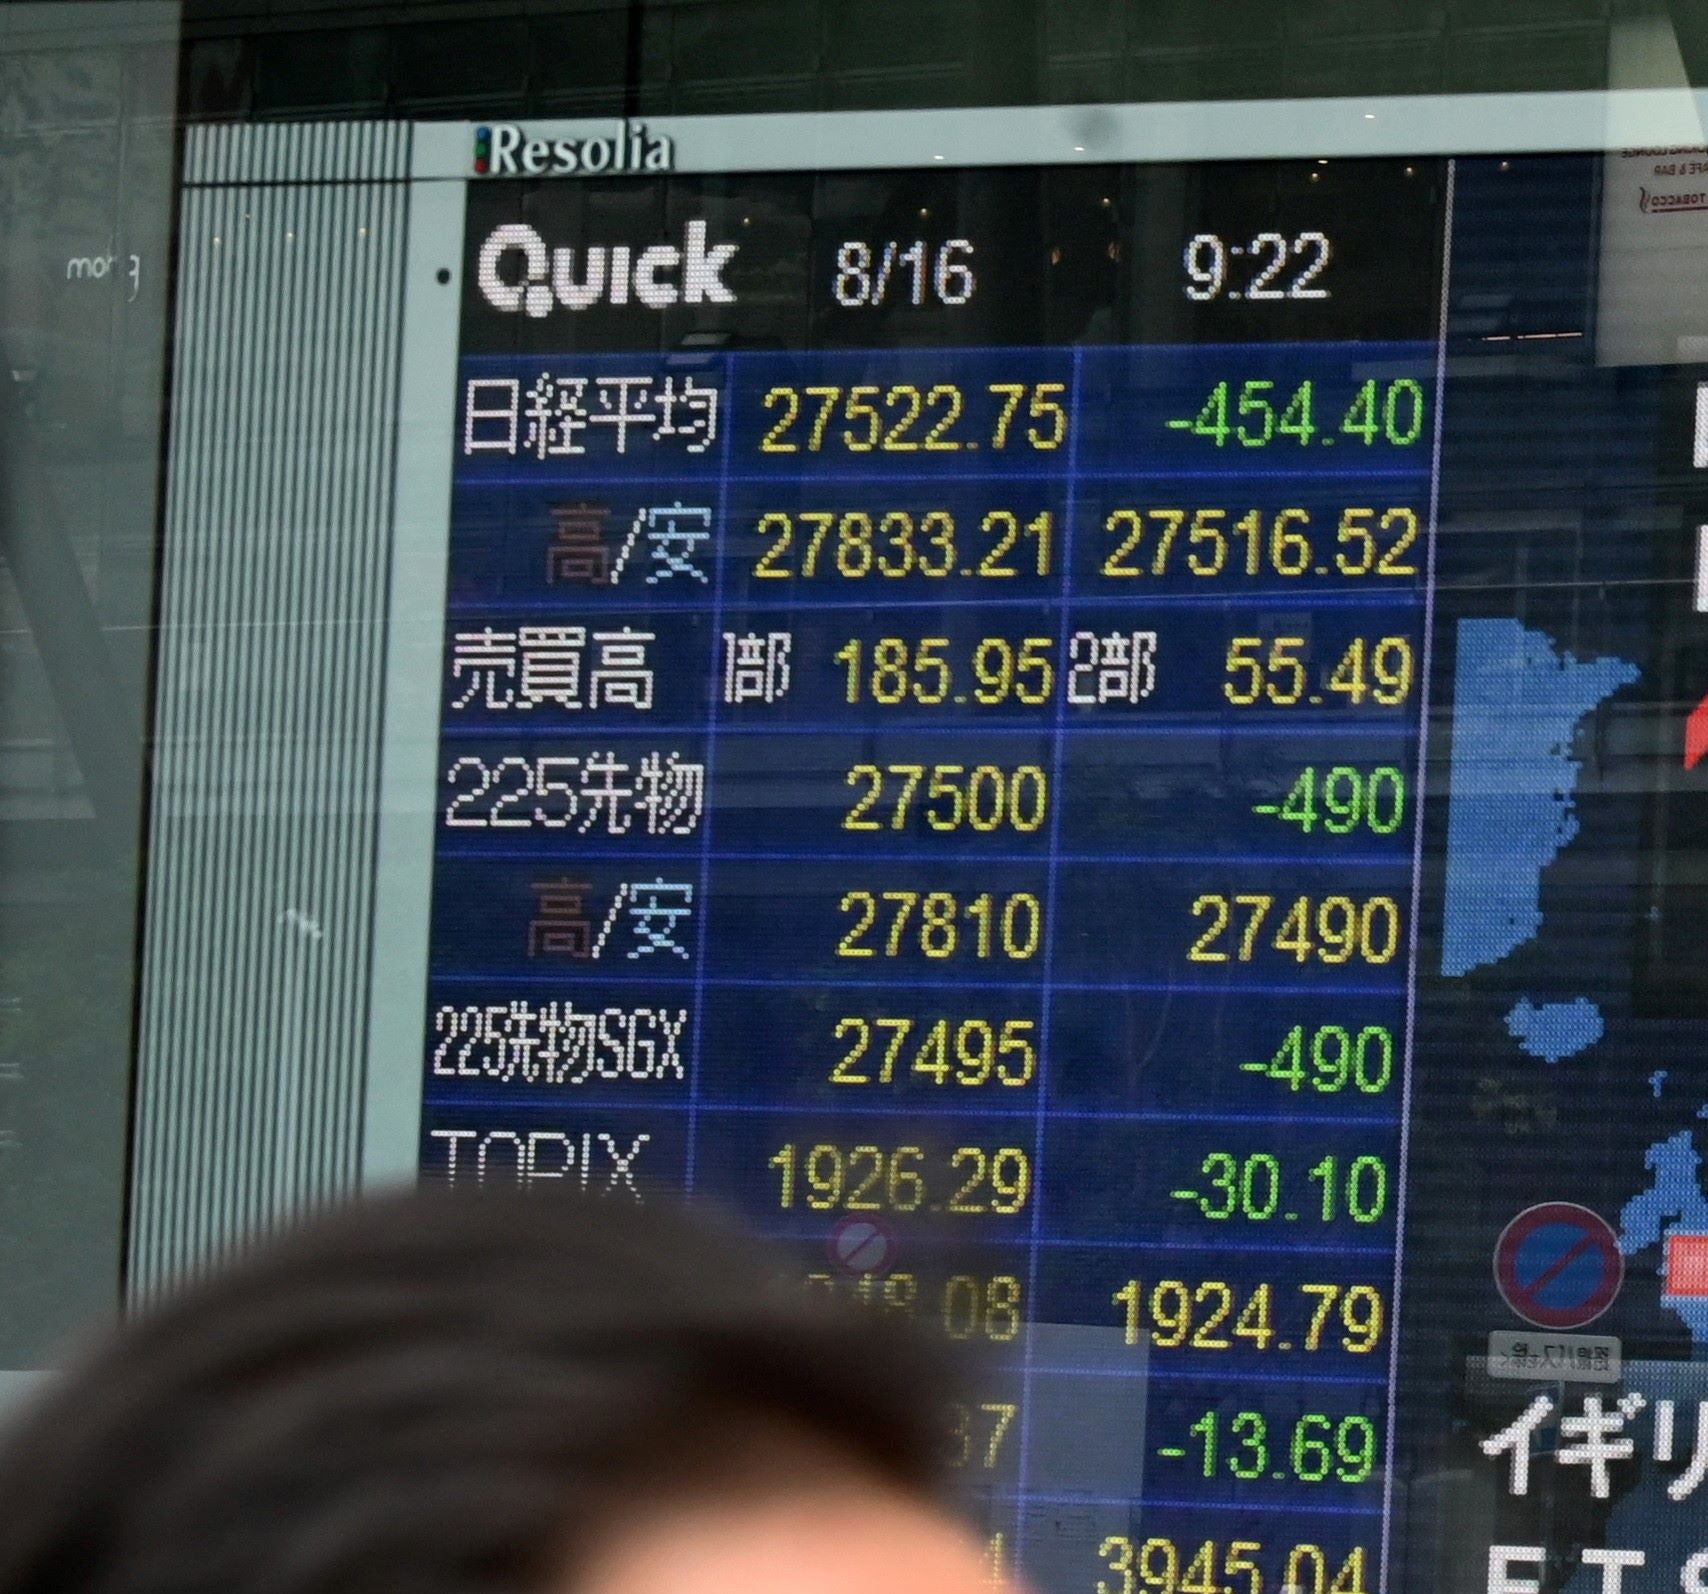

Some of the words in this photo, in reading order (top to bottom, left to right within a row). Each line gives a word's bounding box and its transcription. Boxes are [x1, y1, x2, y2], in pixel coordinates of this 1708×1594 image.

[488, 125, 675, 174] Resolia
[832, 239, 974, 308] 8/16
[1182, 232, 1331, 301] 9:22
[464, 372, 718, 460] 日経平均
[759, 382, 1067, 454] 27522.75
[1165, 378, 1424, 448] -454.40
[544, 499, 711, 585] 高/安
[752, 510, 1055, 578] 27833.21
[1100, 507, 1420, 577] 27516.52
[450, 626, 656, 711] 売買高
[834, 637, 1055, 705] 185.95
[1068, 630, 1158, 706] 2部
[1223, 637, 1412, 705] 55.49
[443, 750, 704, 834] 225先物
[842, 765, 1046, 833] 27500
[1250, 765, 1404, 833] -490
[527, 875, 694, 961] 高/安
[834, 892, 1042, 958] 27810
[1186, 894, 1401, 963] 27490
[430, 999, 685, 1085] 225先物SGX
[828, 1018, 1036, 1085] 27495
[1240, 1025, 1393, 1092] -490
[430, 1130, 651, 1200] TOPIX
[768, 1143, 1031, 1214] 1926.29
[1170, 1152, 1386, 1221] -30.10
[1113, 1280, 1382, 1351] 1924.79
[1157, 1410, 1378, 1483] -13.69
